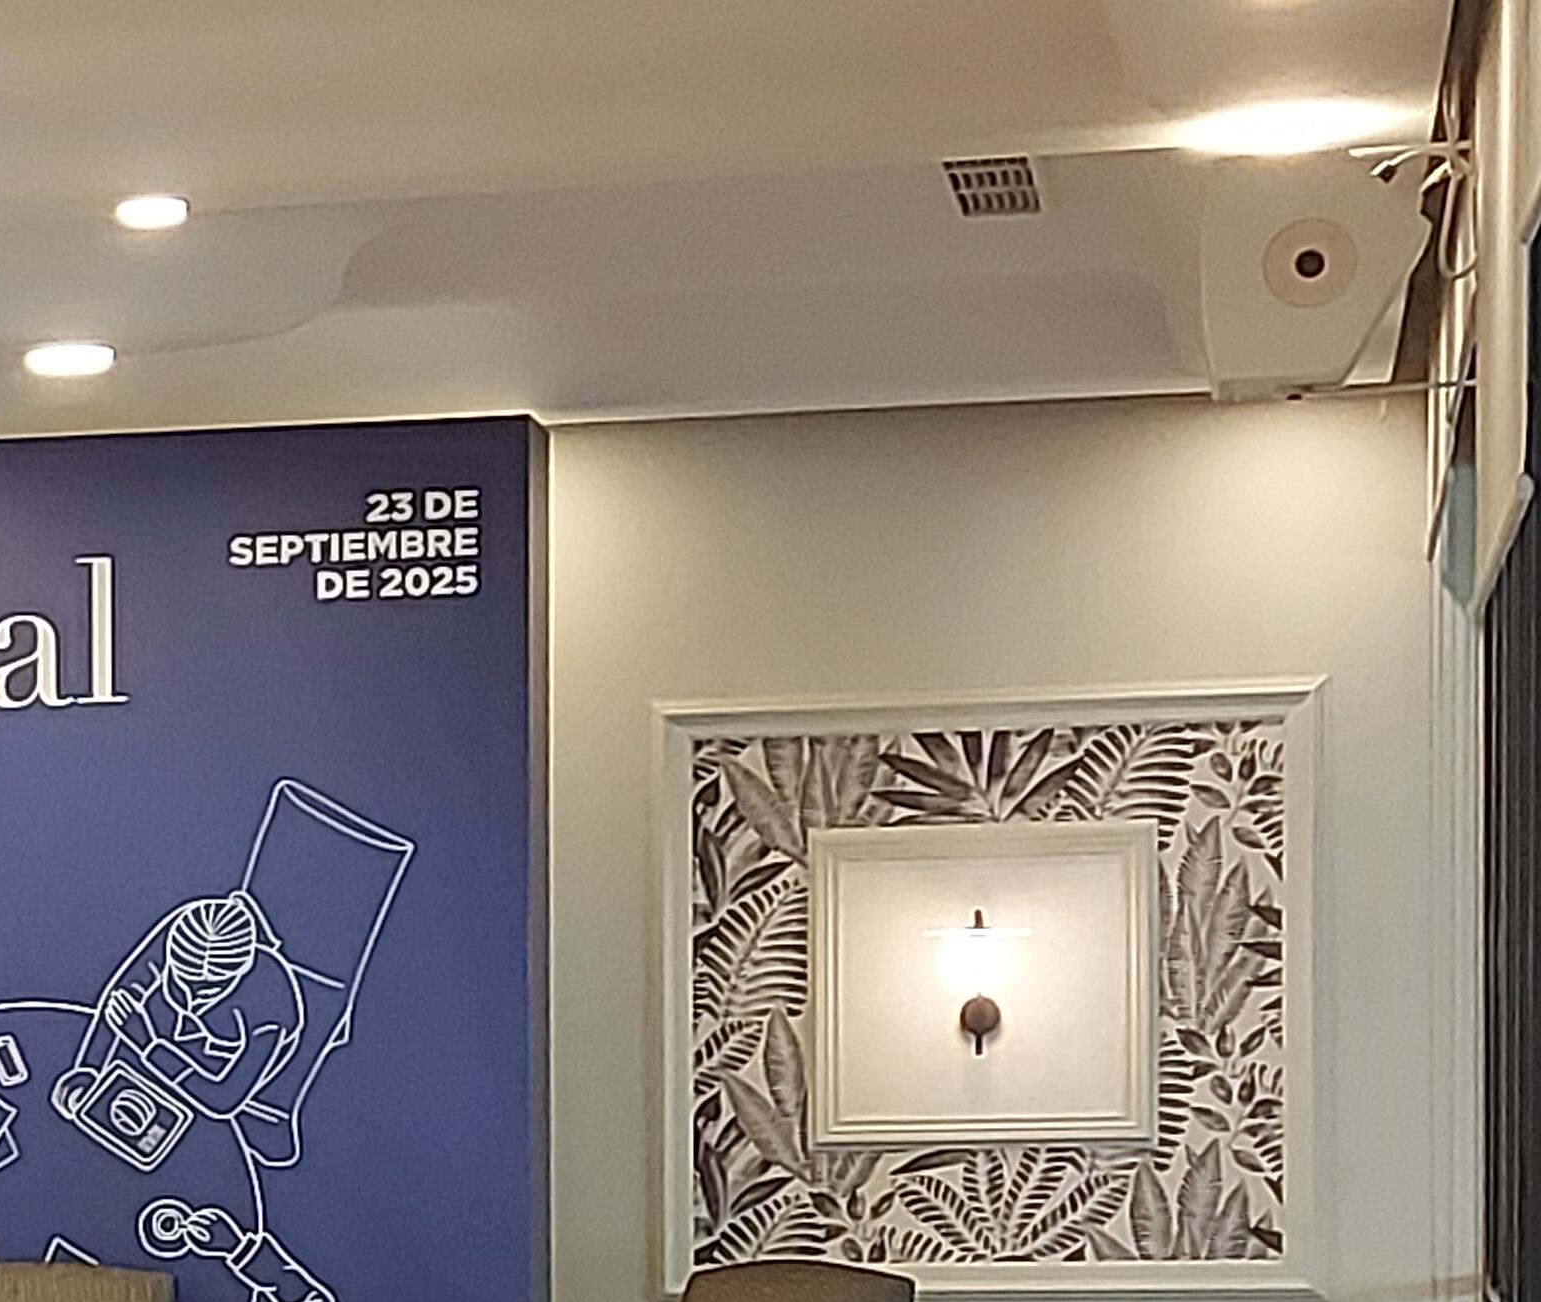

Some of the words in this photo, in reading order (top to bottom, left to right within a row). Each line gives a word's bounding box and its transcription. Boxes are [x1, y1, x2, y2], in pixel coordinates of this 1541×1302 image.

[366, 492, 413, 522] 23
[425, 490, 479, 520] DE
[229, 527, 479, 566] SEPTIEMBRE
[317, 569, 371, 600] DE
[379, 565, 479, 597] 2025
